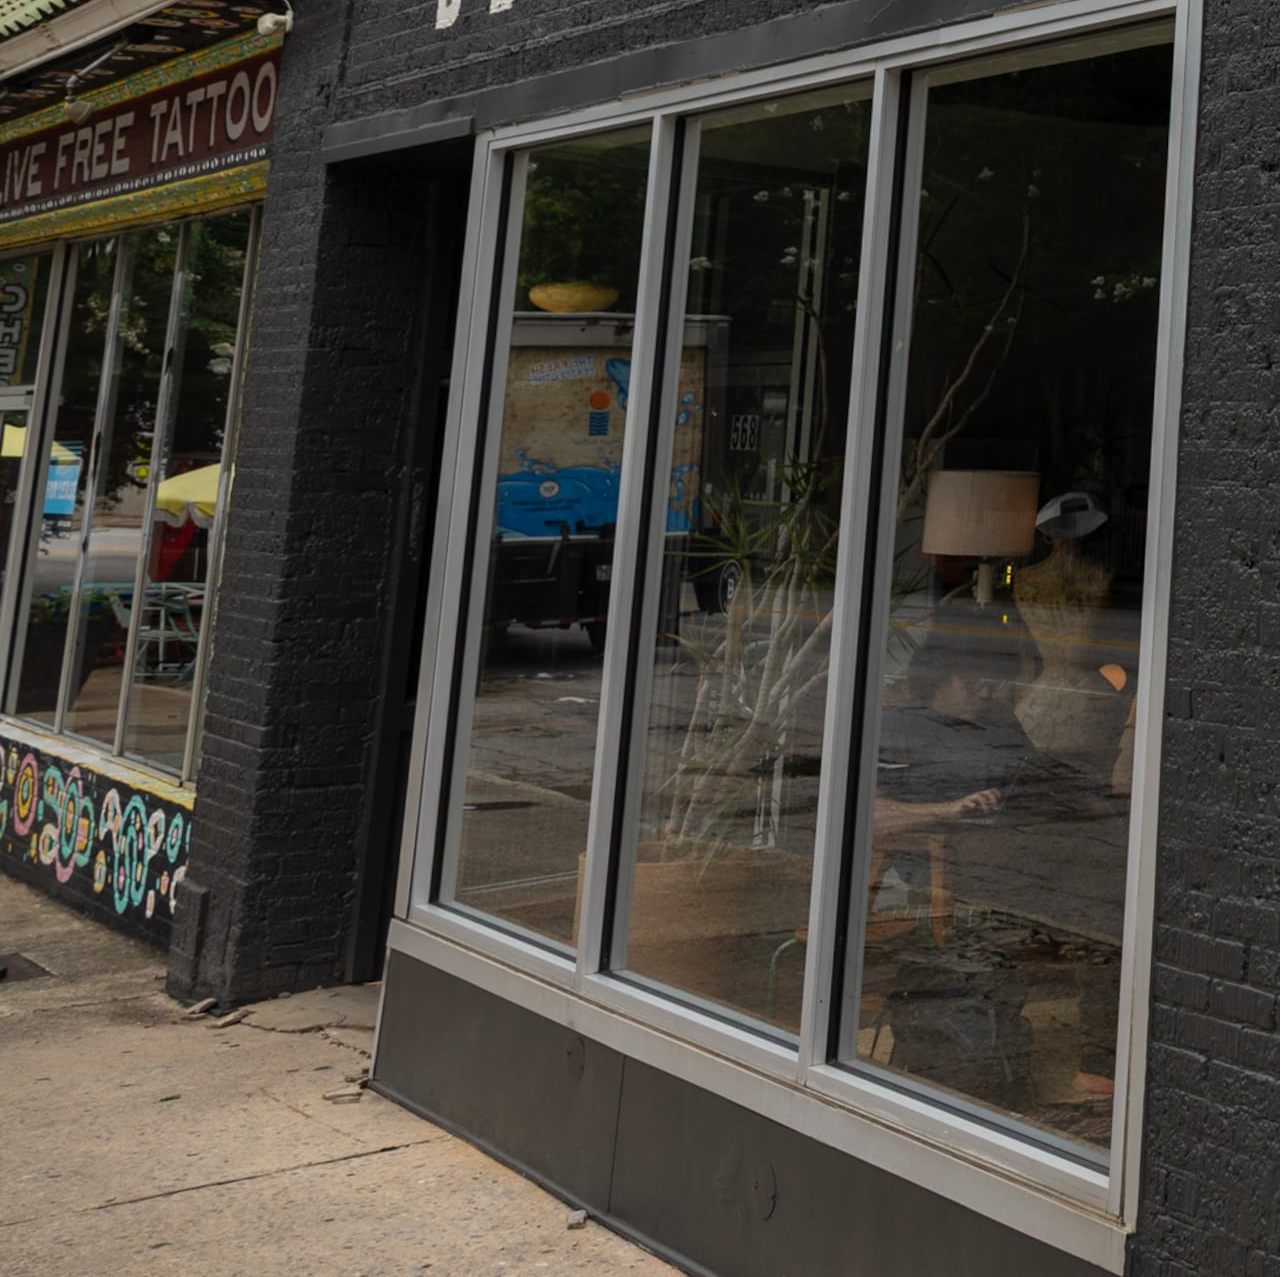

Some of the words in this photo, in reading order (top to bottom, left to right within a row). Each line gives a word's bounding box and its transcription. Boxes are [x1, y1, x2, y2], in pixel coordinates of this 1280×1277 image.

[0, 141, 47, 205] IVE
[54, 111, 134, 191] FREE
[150, 60, 277, 165] TATTOO
[731, 415, 758, 450] 568
